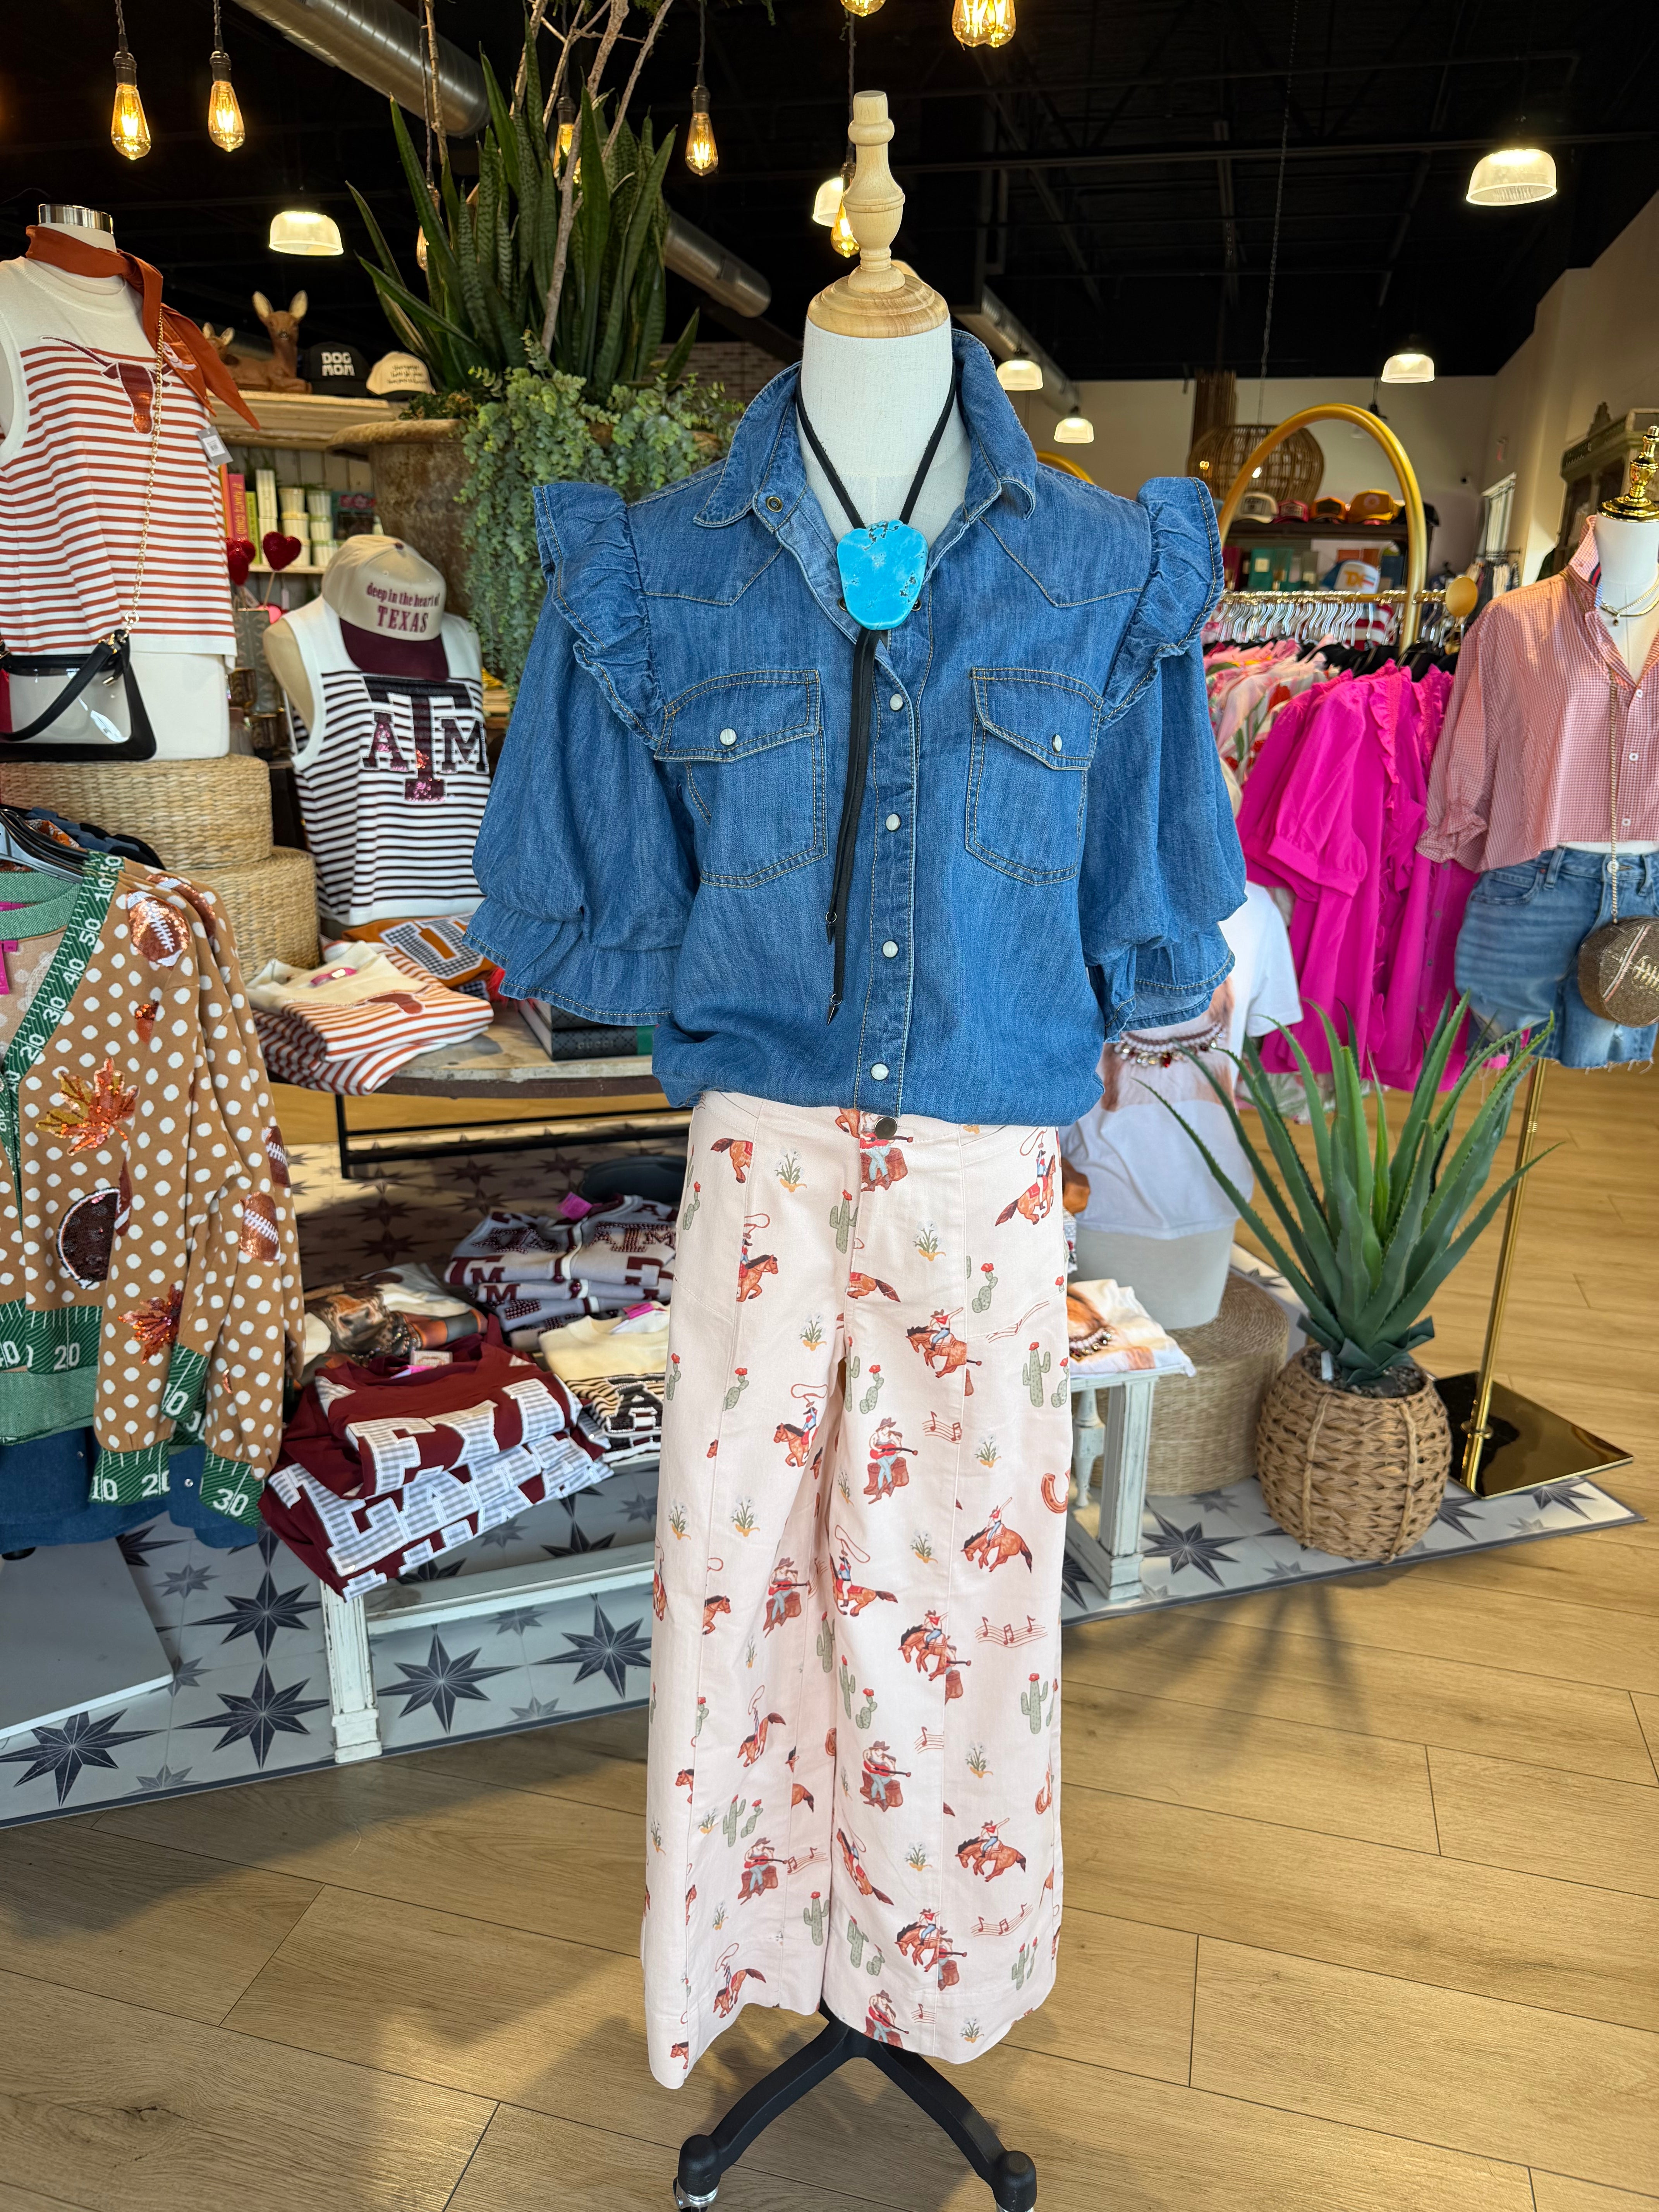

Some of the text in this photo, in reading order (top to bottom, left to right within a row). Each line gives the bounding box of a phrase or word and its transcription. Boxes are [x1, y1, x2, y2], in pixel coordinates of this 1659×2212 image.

[321, 352, 352, 364] DOG
[322, 364, 355, 376] MOM
[367, 582, 387, 603] deep
[388, 589, 398, 603] in
[399, 592, 413, 606] the
[414, 594, 434, 607] heart
[377, 605, 429, 633] TEXAS
[79, 918, 101, 946] 50
[62, 958, 86, 985] 40
[42, 996, 67, 1023] 30
[20, 1033, 46, 1061] 20
[578, 1041, 613, 1049] GUCCI
[53, 1343, 80, 1371] 20
[92, 1475, 118, 1501] 10
[213, 1488, 249, 1517] 30
